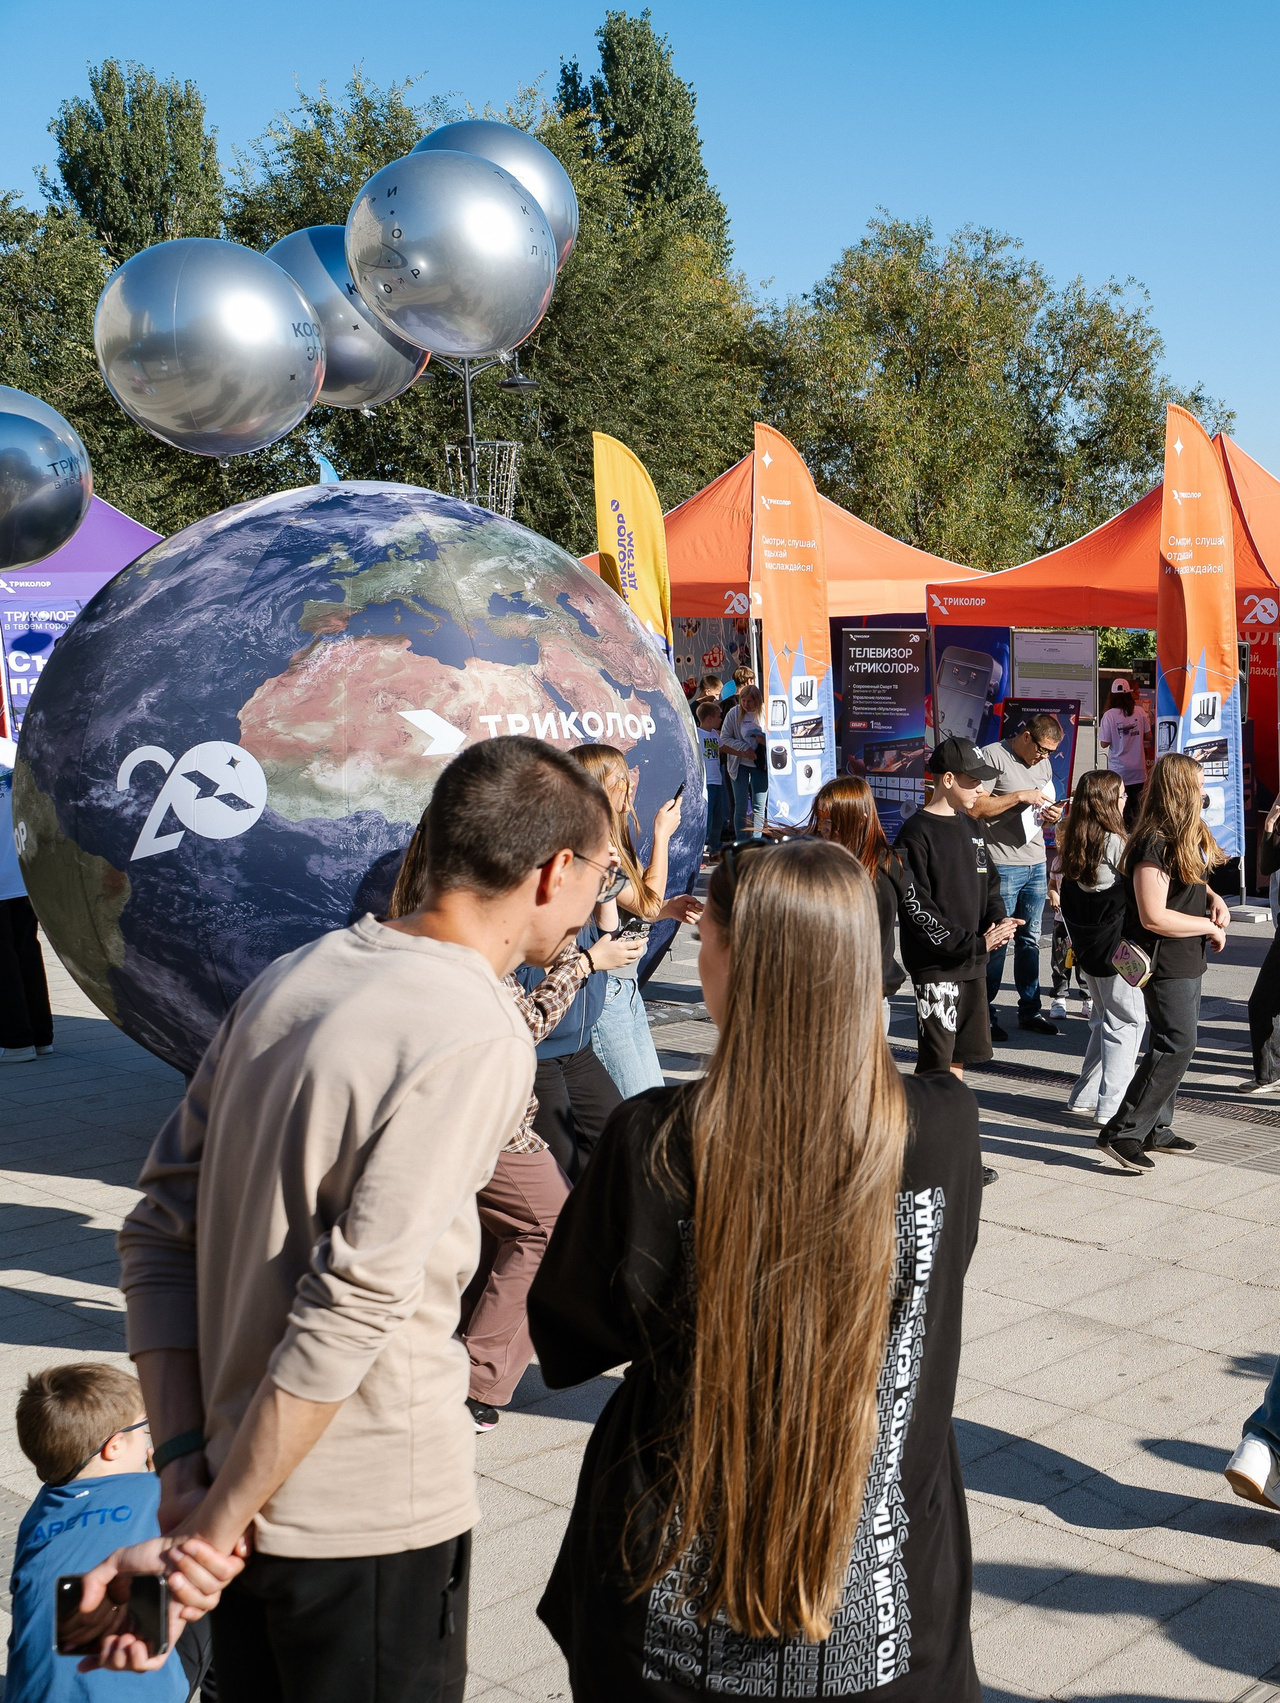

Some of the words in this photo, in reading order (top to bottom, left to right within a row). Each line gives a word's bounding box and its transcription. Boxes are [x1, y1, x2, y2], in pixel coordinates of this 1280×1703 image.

[627, 530, 638, 591] ДЕТЯМ
[9, 580, 51, 588] ТРИКОЛОР
[943, 597, 987, 606] ТРИКОЛОР
[1242, 594, 1279, 625] 20
[4, 610, 78, 623] ТРИКОЛОР
[4, 623, 11, 631] в
[14, 623, 43, 631] твоем
[849, 647, 913, 659] ТЕЛЕВИЗОР
[848, 662, 920, 674] «ТРИКОЛОР»
[479, 711, 657, 741] ТРИКОЛОР
[915, 1187, 935, 1281] ПАНДА
[895, 1323, 915, 1389] ЕСЛИ
[888, 1391, 911, 1450] КТО,
[872, 1566, 896, 1635] ЕСЛИ
[784, 1645, 820, 1664] НЕ
[876, 1632, 898, 1687] КТО,
[783, 1663, 819, 1681] НЕ
[706, 1673, 778, 1697] ЕСЛИ
[781, 1679, 818, 1698] НЕ
